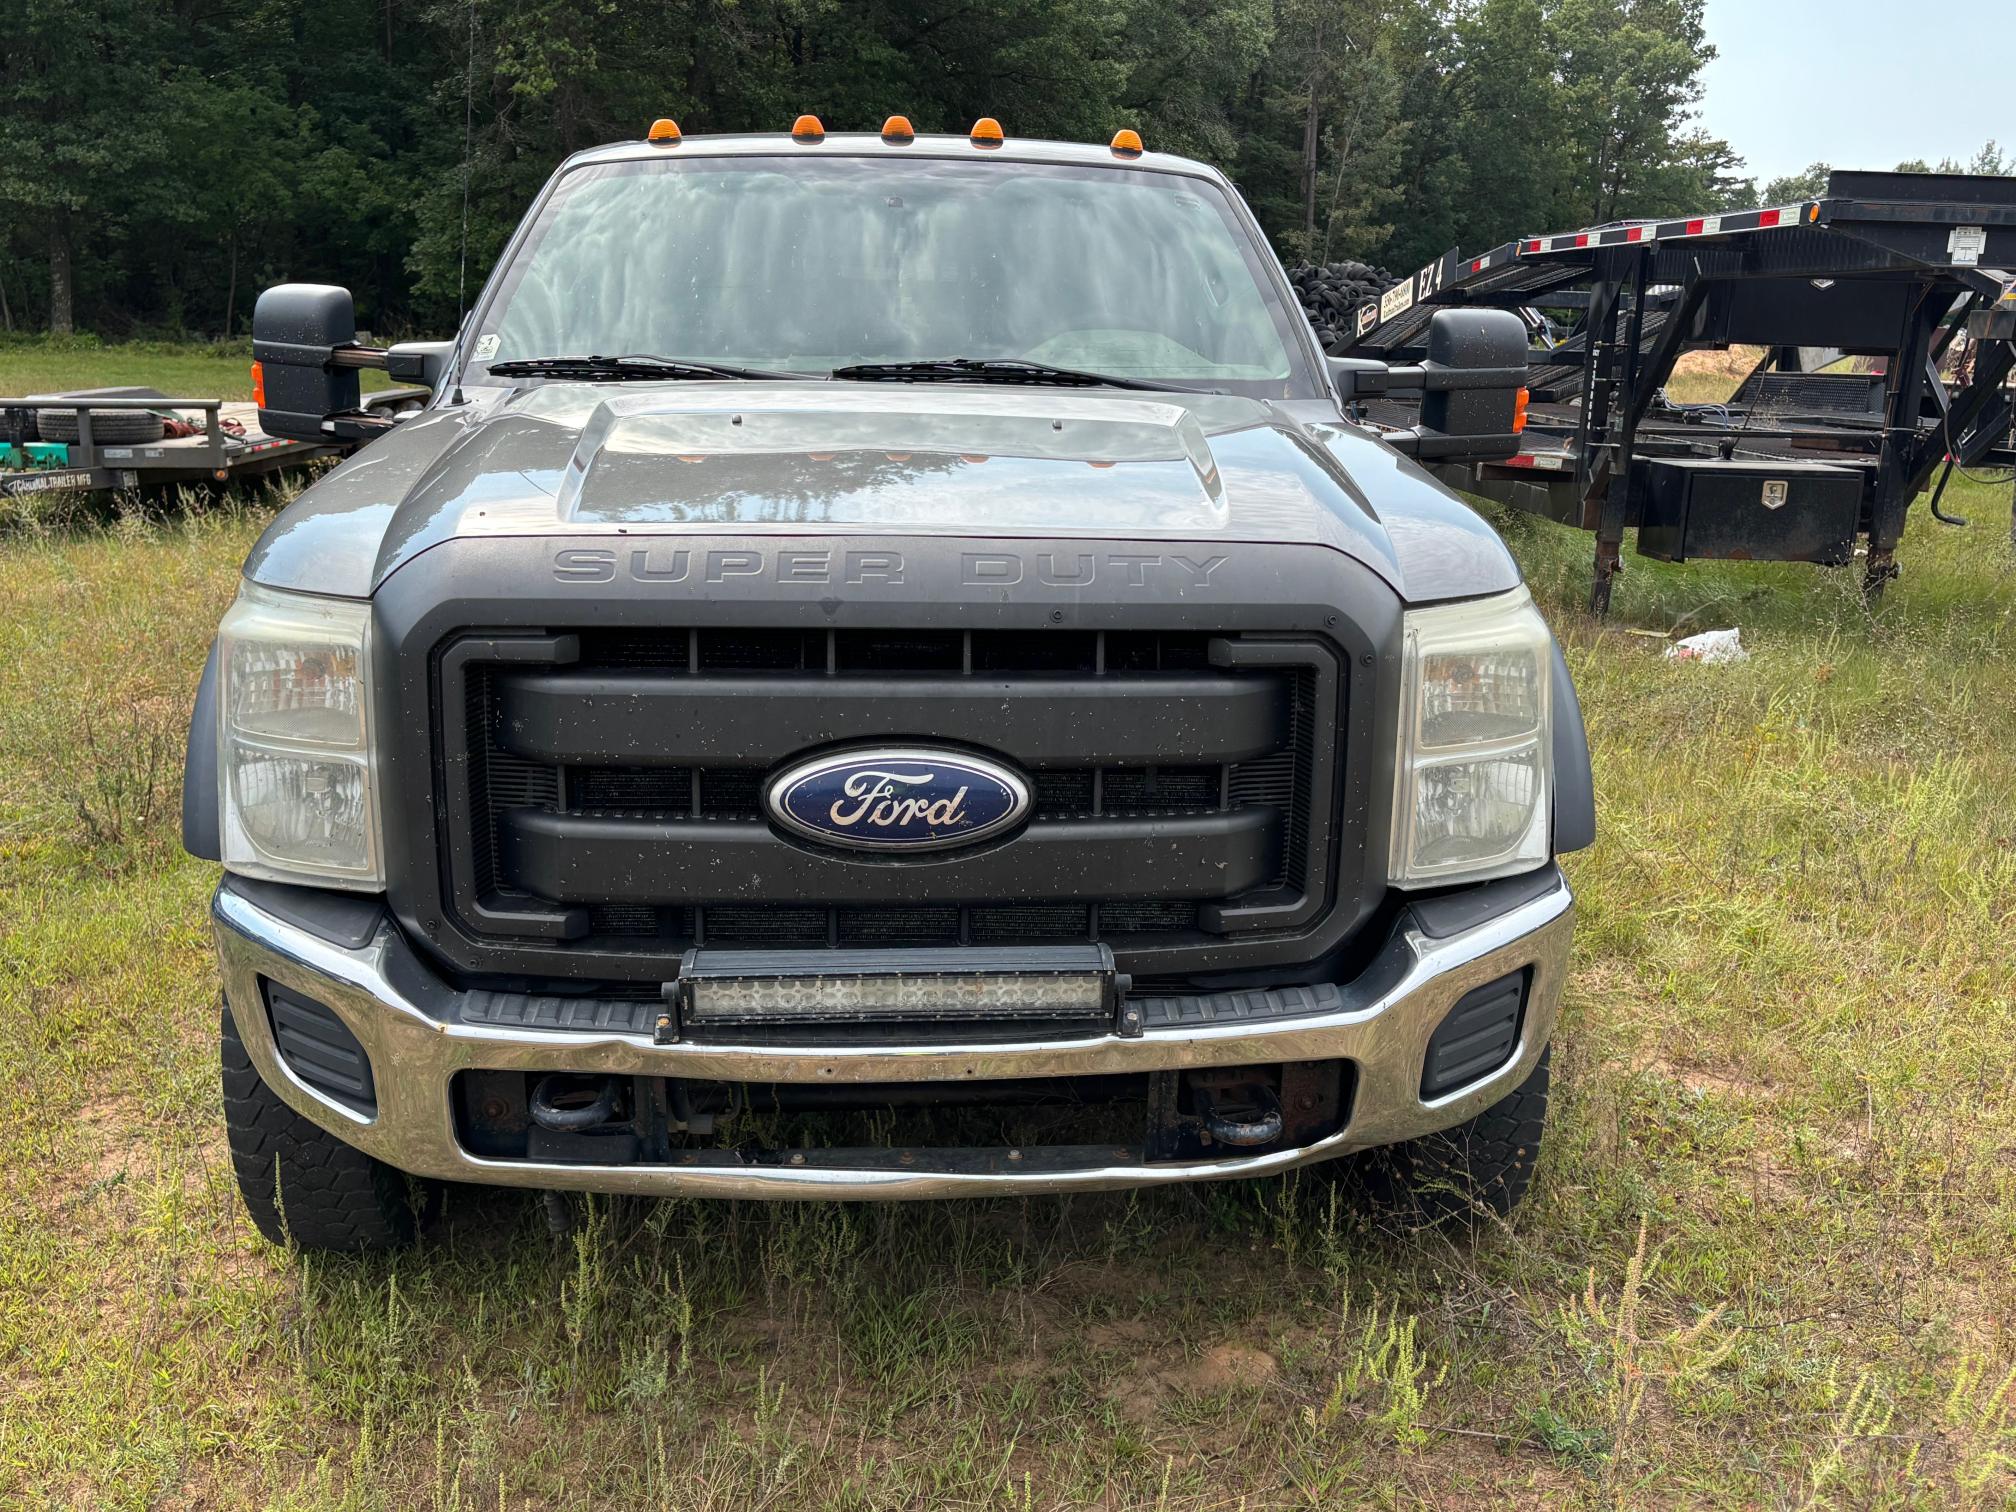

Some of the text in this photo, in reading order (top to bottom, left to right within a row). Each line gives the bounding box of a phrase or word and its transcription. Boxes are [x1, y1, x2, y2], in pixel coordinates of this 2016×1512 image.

[1418, 257, 1444, 302] EZ 4
[49, 473, 76, 489] TRAILER
[77, 473, 92, 487] MFG
[553, 549, 1230, 587] SUPER DUTY
[829, 770, 969, 826] Ford
